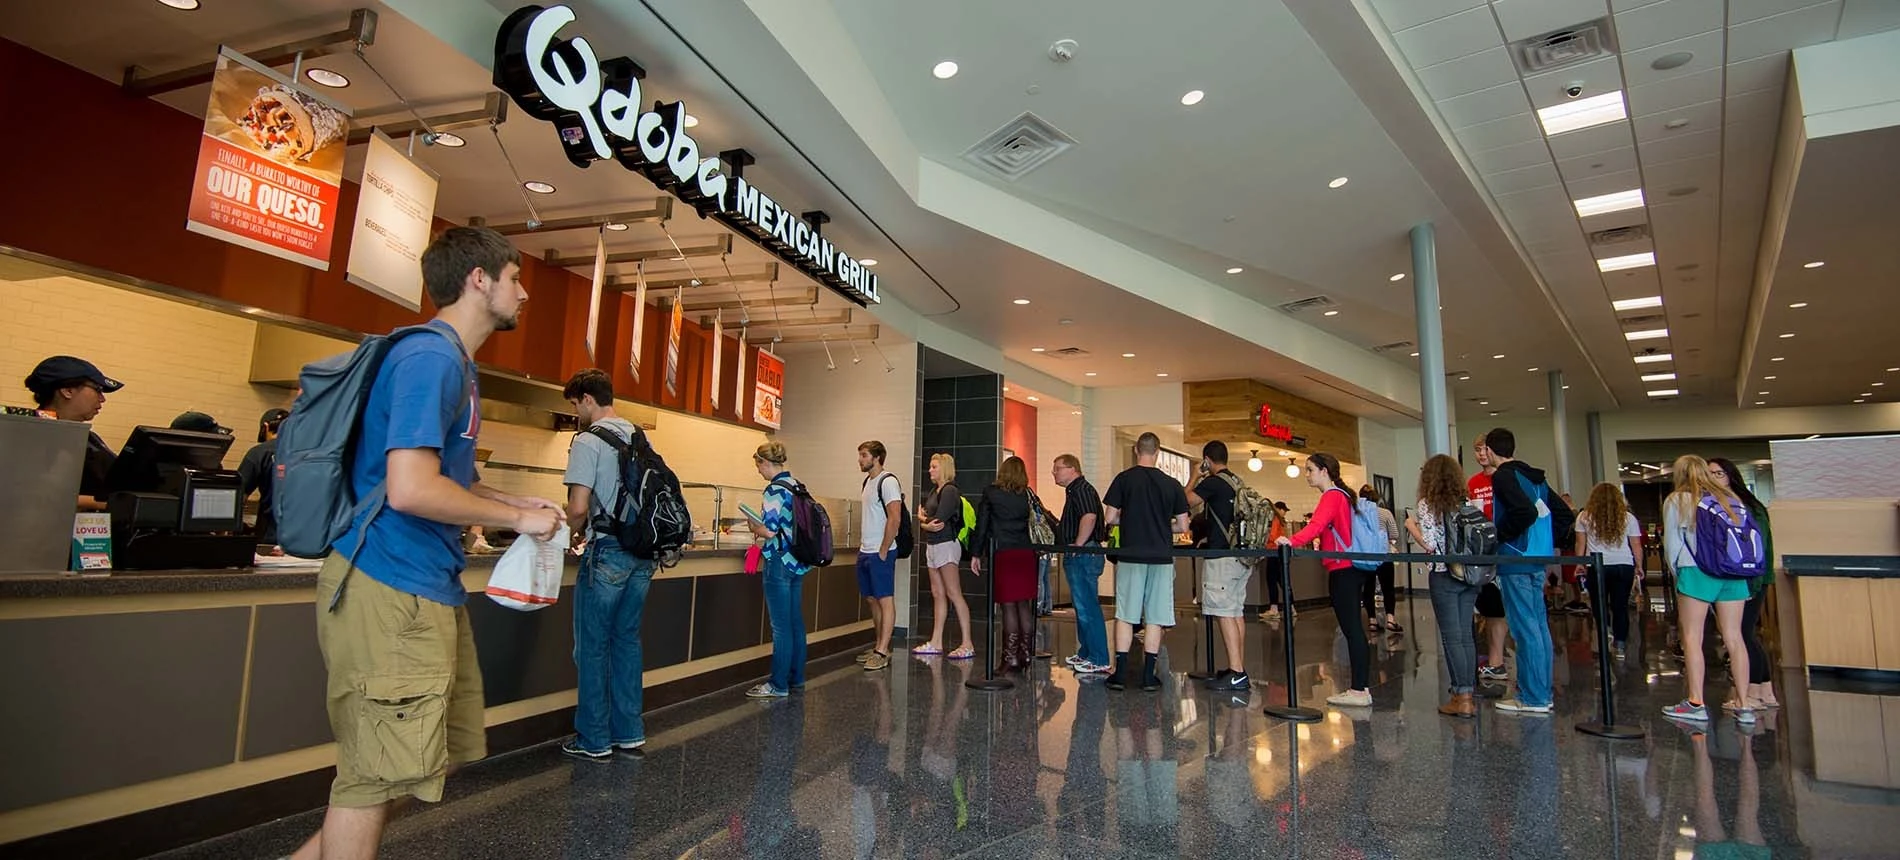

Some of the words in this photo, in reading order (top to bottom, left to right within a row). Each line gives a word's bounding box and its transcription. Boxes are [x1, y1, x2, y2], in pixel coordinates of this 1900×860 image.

[218, 149, 248, 171] FINALLY,
[249, 160, 254, 173] A
[256, 163, 285, 185] BURRITO
[286, 175, 311, 194] WORTHY
[312, 184, 320, 198] OF
[525, 5, 727, 212] Qdoba
[736, 176, 834, 275] MEXICAN
[837, 251, 881, 304] GRILL
[207, 165, 252, 204] OUR
[257, 184, 325, 230] QUESO.
